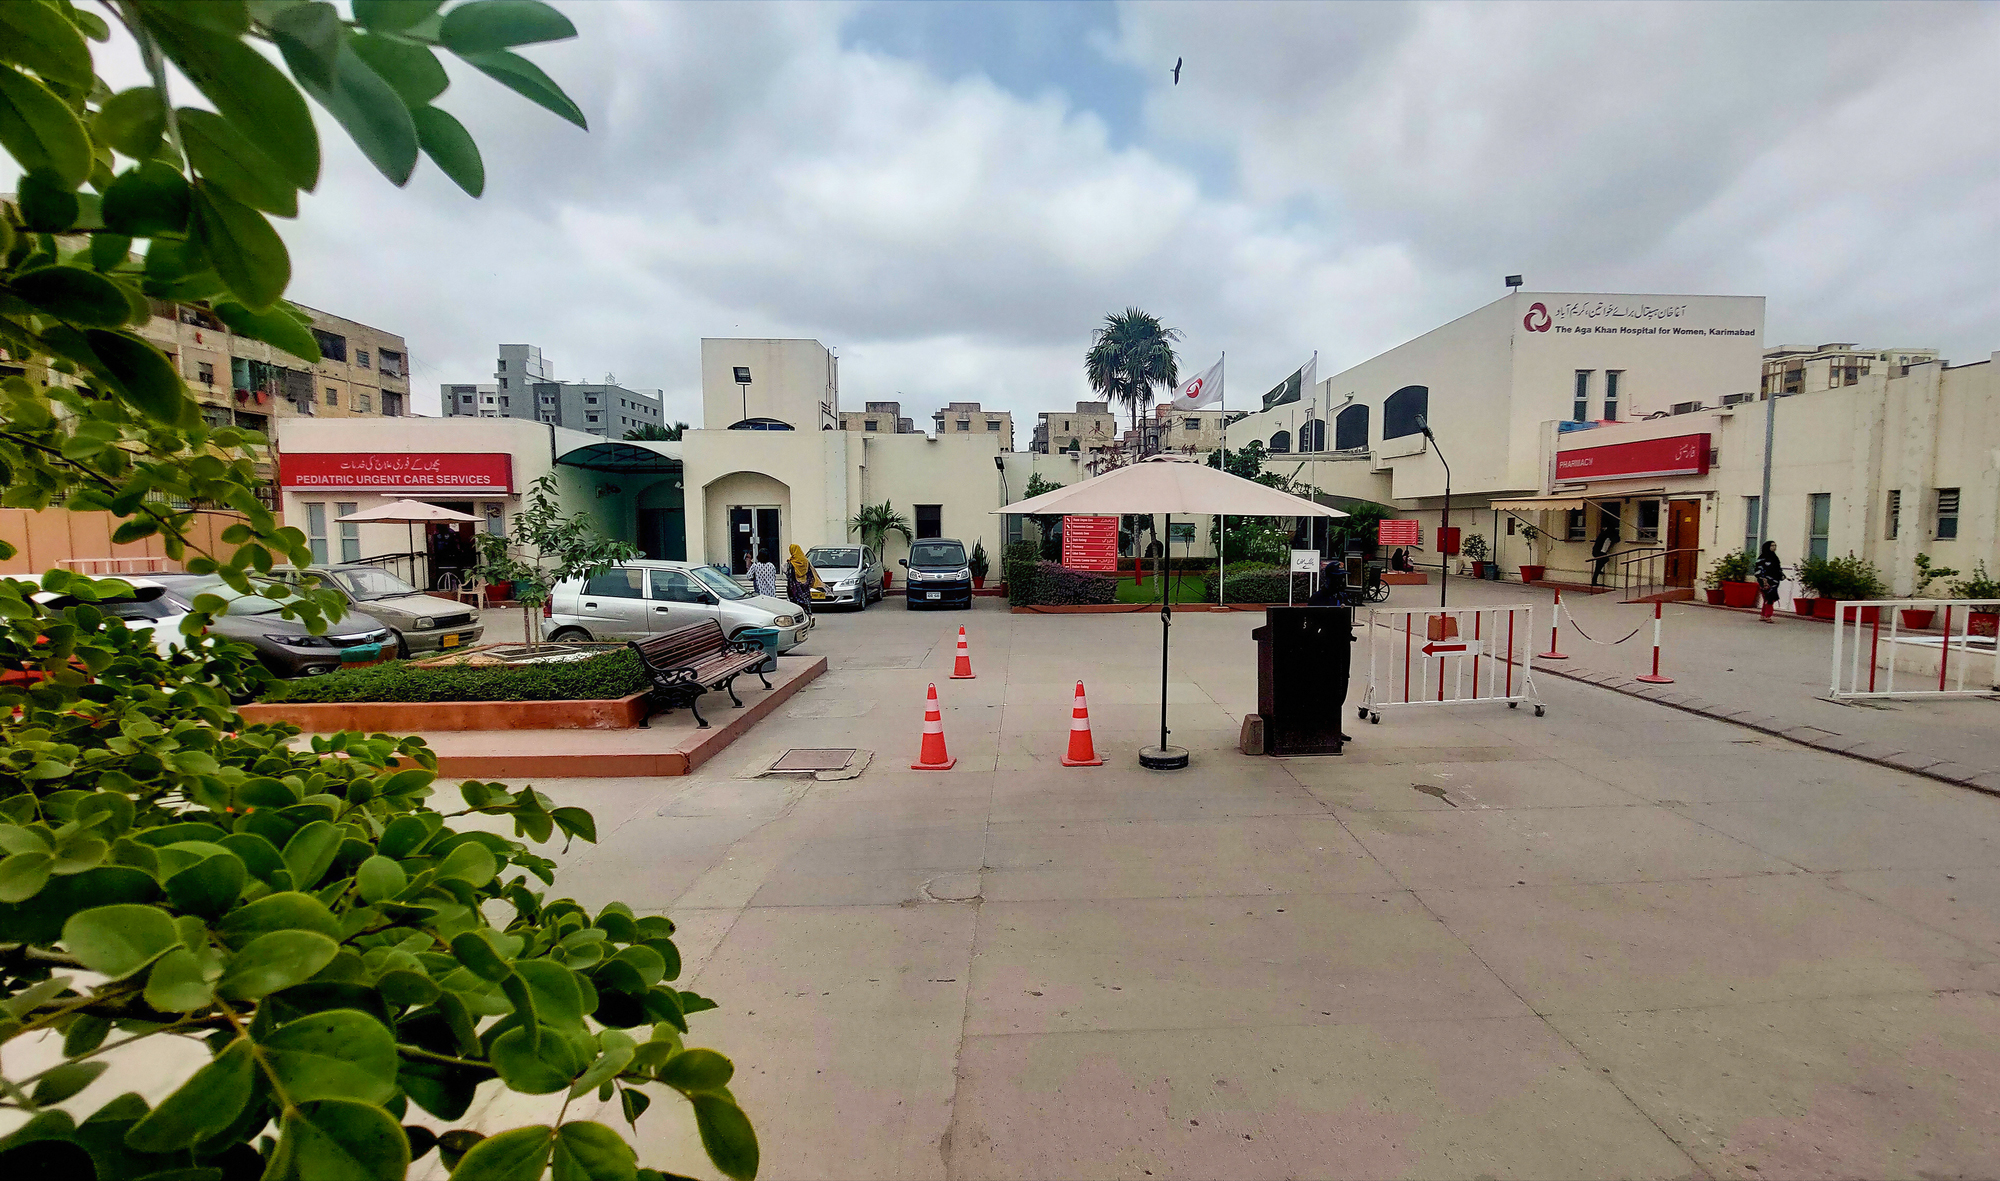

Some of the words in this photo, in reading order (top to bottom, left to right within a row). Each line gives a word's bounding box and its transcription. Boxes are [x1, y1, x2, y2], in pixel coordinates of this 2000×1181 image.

[1555, 304, 1571, 319] آباد
[1570, 301, 1589, 317] کریم
[1613, 306, 1635, 318] برائے
[1635, 304, 1659, 321] ہسپتال
[1658, 306, 1674, 319] خان
[1675, 305, 1688, 317] آغا
[1555, 325, 1572, 334] The
[1575, 326, 1592, 336] Aga
[1594, 326, 1618, 335] Khan
[1620, 326, 1657, 336] Hospital
[1658, 327, 1671, 335] for
[1673, 327, 1707, 337] Women,
[1709, 328, 1756, 337] Karimabad
[340, 459, 366, 470] خدمات
[365, 455, 376, 471] کی
[374, 459, 392, 471] علاج
[392, 457, 410, 471] فوری
[411, 458, 423, 471] کے
[424, 458, 441, 473] بچوں
[1559, 457, 1594, 469] PHARMACY
[296, 475, 354, 485] PEDIATRIC
[356, 475, 401, 485] URGENT
[403, 475, 435, 485] CARE
[436, 475, 491, 485] SERVICES
